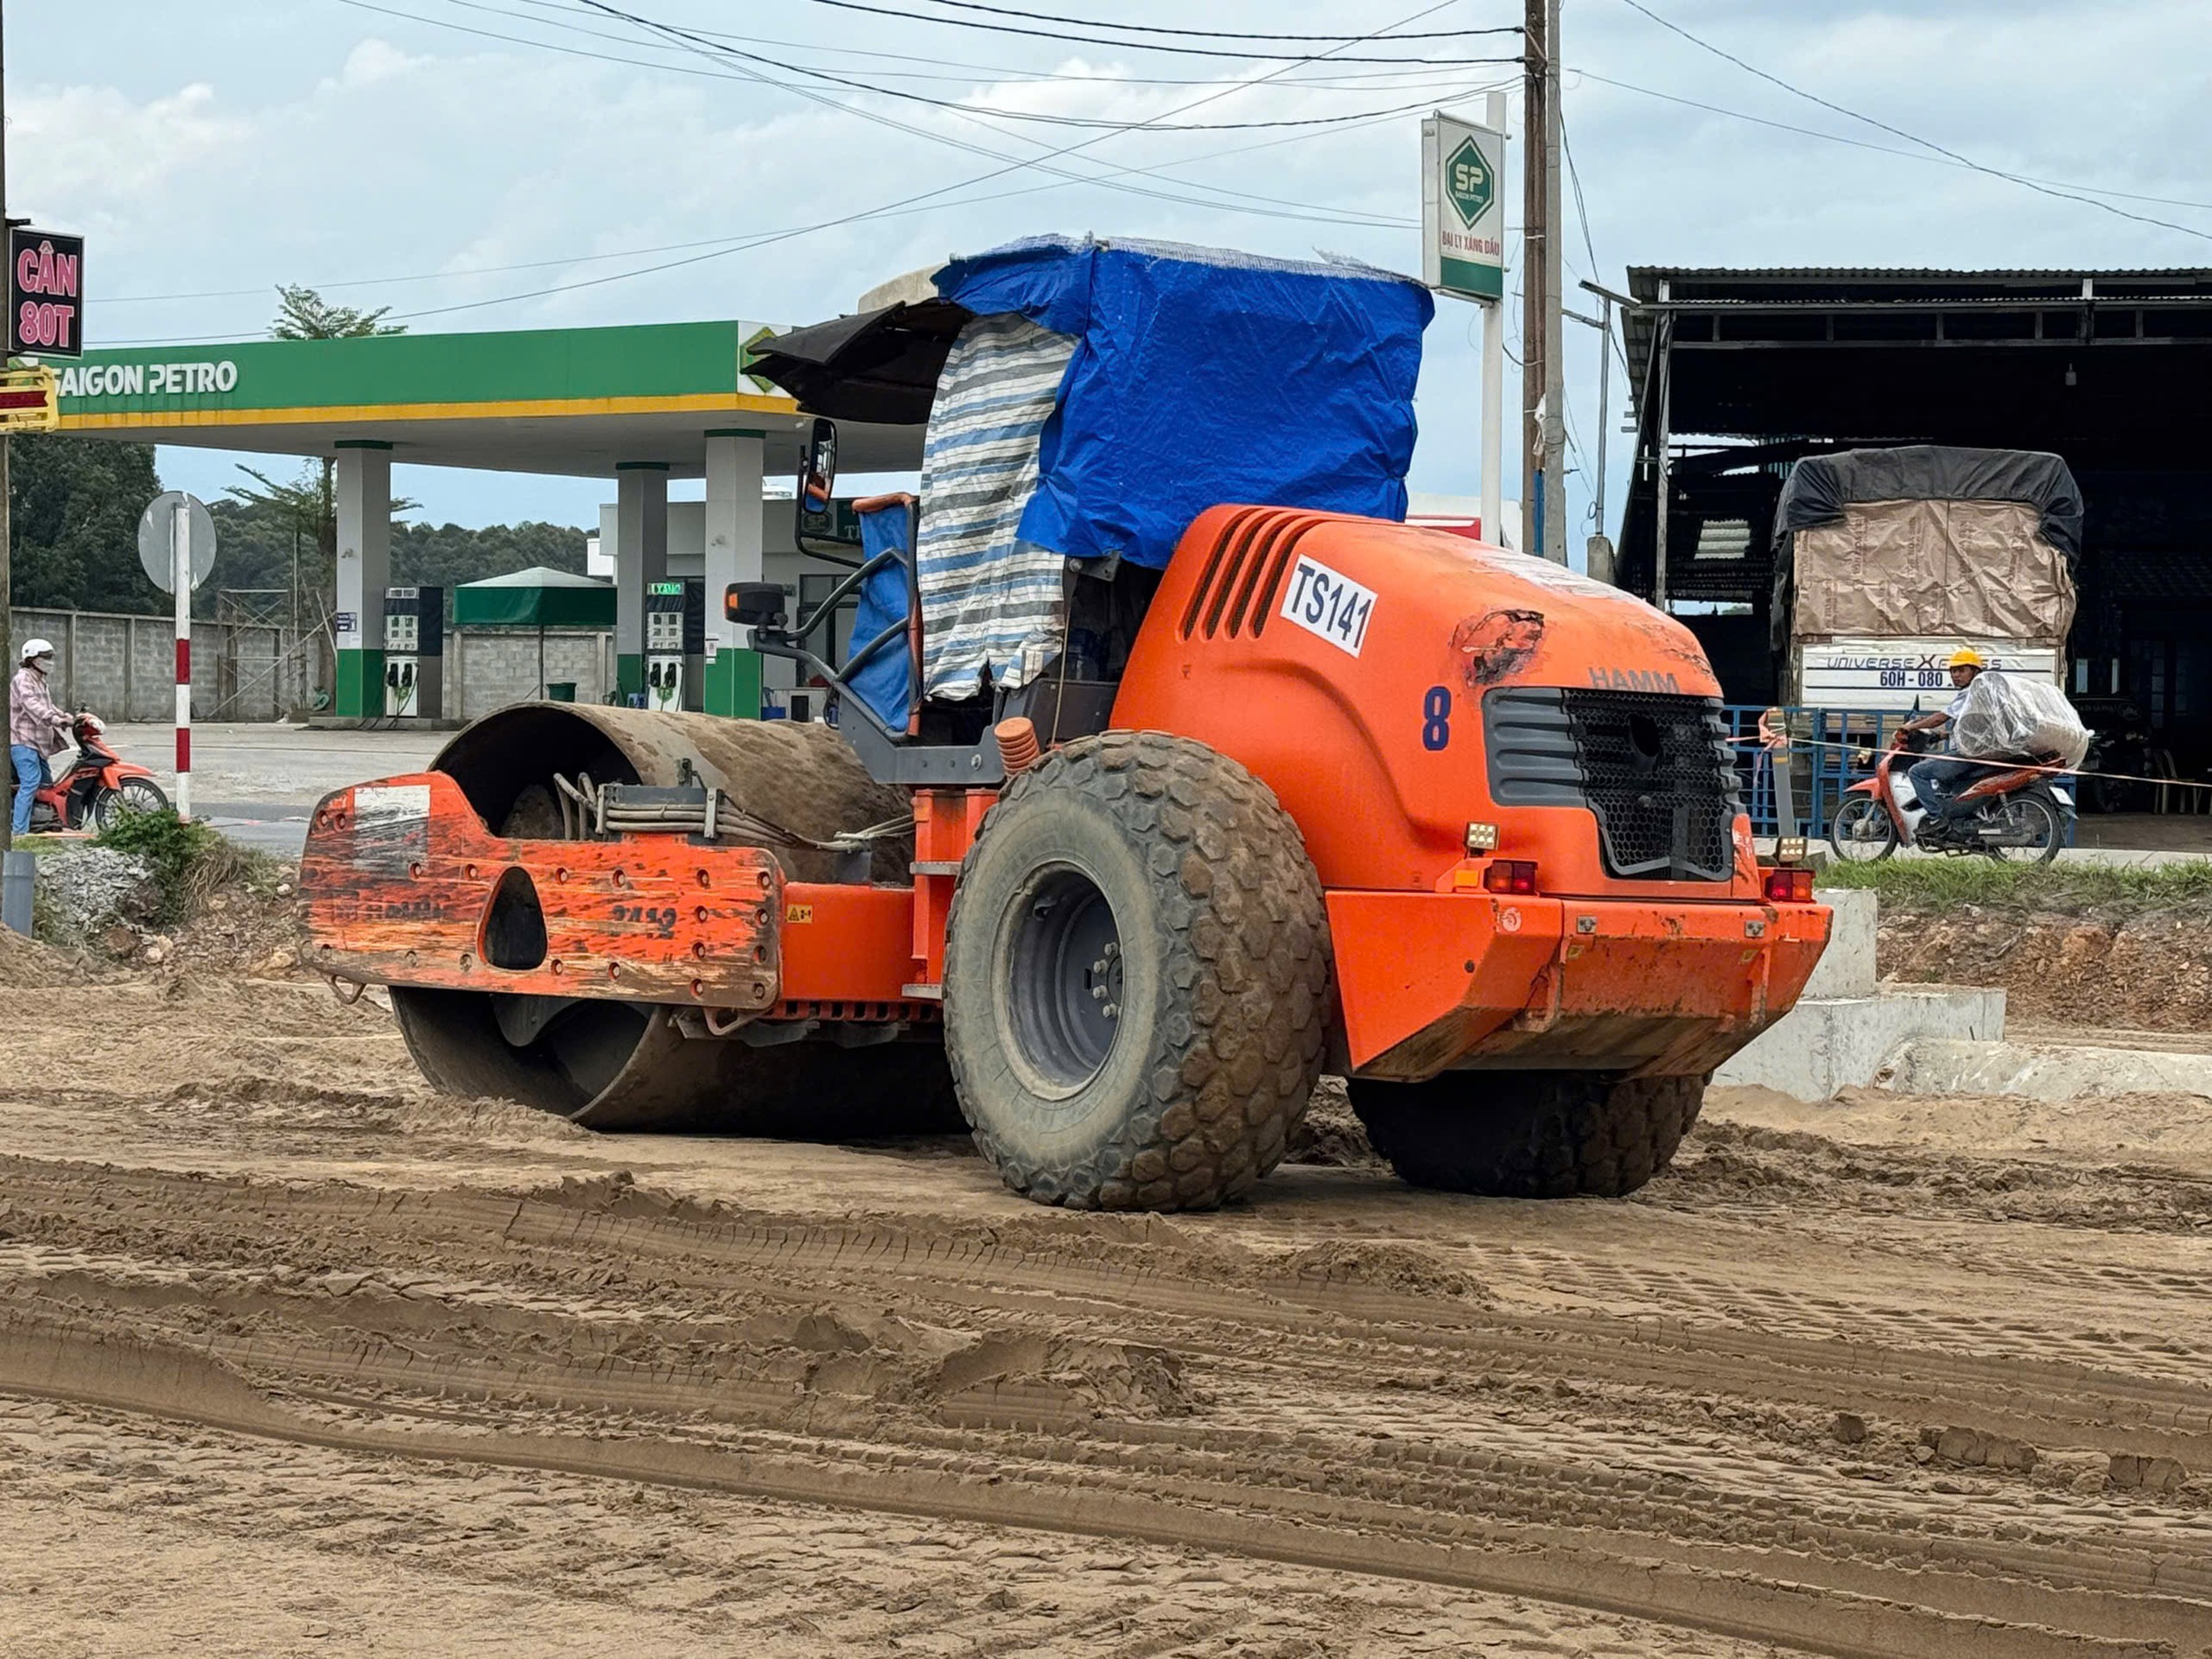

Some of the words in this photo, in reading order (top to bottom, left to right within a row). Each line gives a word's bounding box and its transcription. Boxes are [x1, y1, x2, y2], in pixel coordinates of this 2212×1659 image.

[1456, 163, 1484, 192] SP
[17, 240, 77, 297] CÂN
[19, 301, 74, 347] 80T
[149, 360, 238, 395] PETRO
[1292, 563, 1372, 649] TS141
[1587, 666, 1680, 693] HAMM
[1880, 671, 1905, 687] 60H
[1422, 685, 1452, 752] 8
